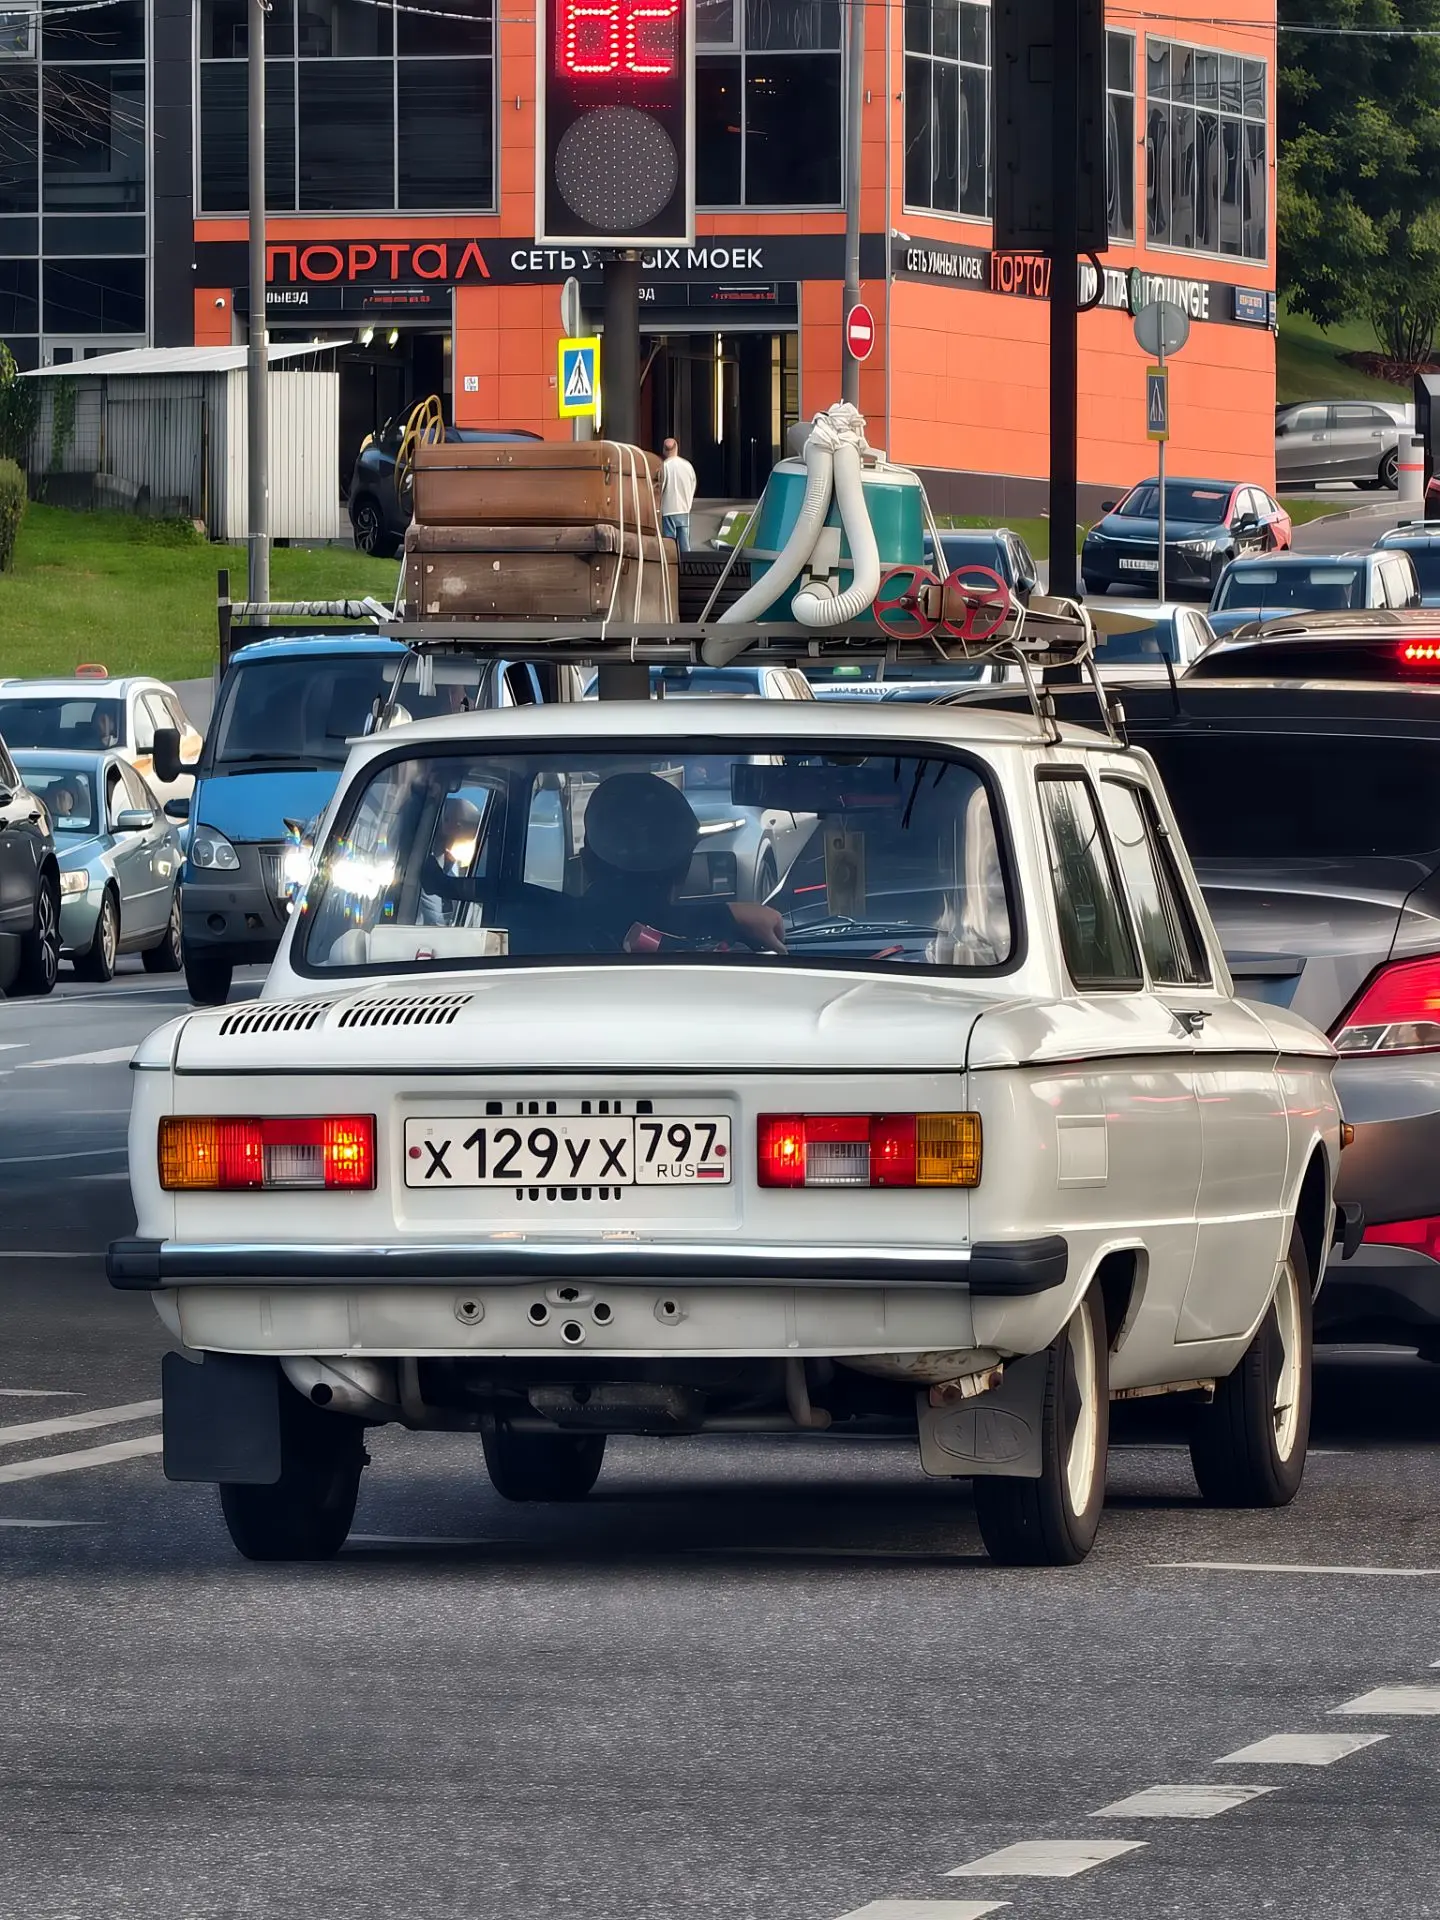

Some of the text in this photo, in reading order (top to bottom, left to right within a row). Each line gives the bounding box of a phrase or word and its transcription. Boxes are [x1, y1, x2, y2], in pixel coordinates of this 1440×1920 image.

[510, 248, 764, 270] СЕТЬ УЫХ МОЕК
[906, 248, 983, 280] СЕТЬ УМНЫХ МОЕК
[639, 1123, 717, 1162] 797
[656, 1163, 696, 1178] RUS
